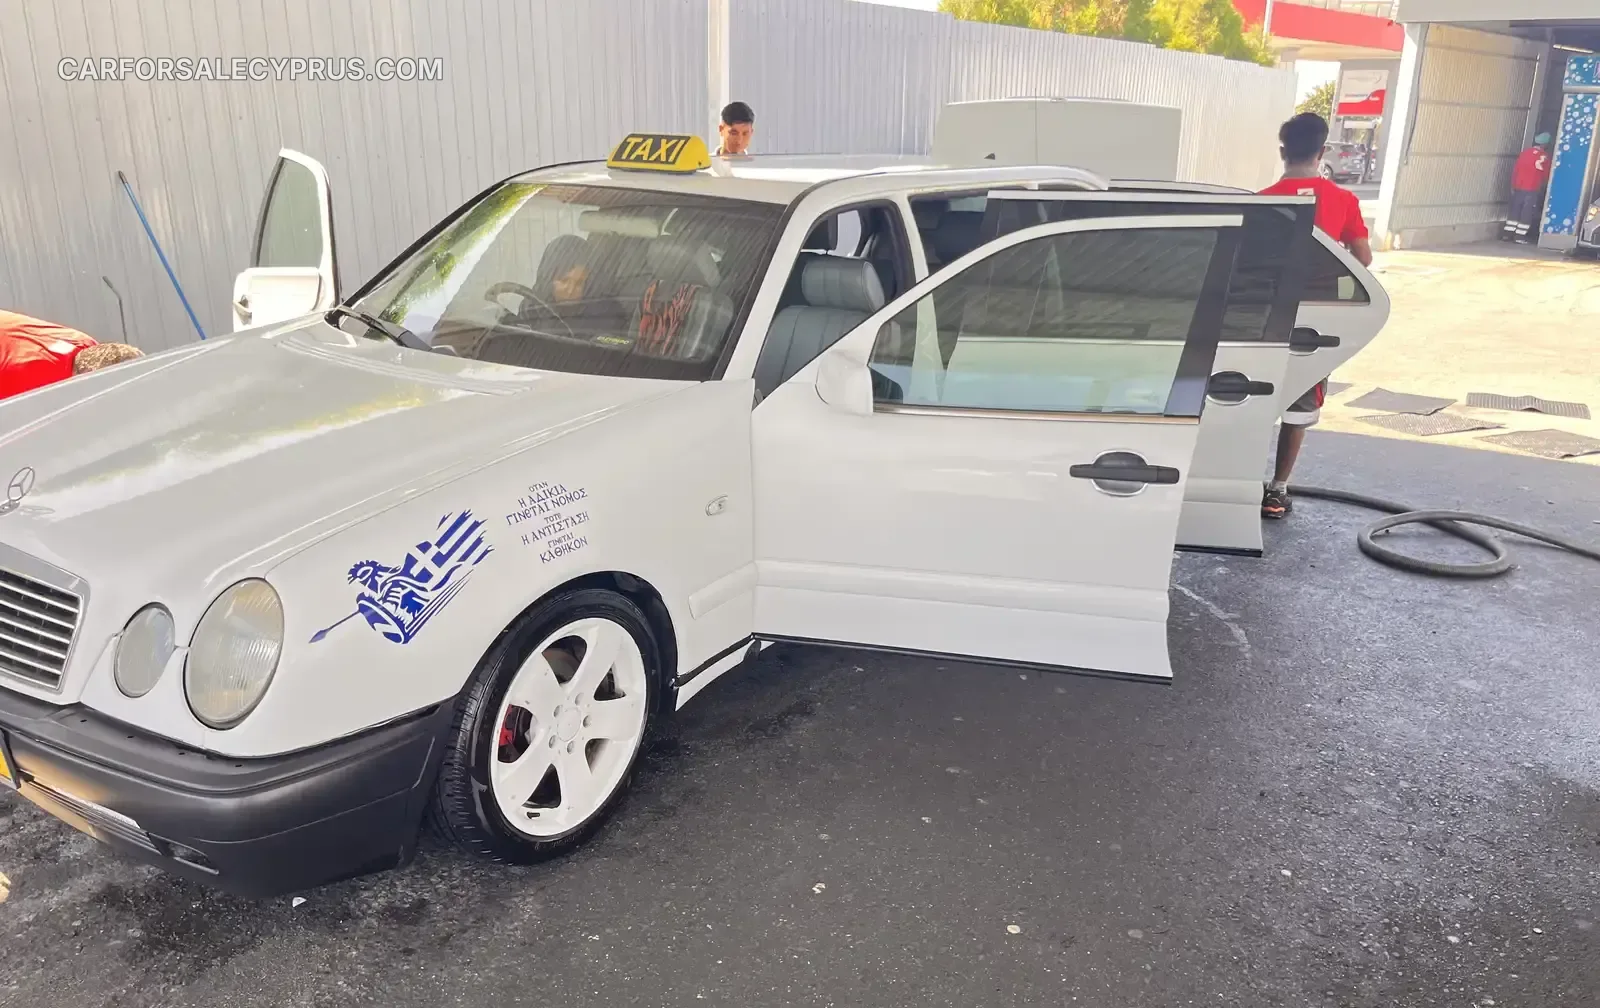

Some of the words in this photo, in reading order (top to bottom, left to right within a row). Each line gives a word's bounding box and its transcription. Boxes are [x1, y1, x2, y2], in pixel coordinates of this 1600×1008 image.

[621, 137, 686, 162] TAXI
[518, 498, 527, 508] Η
[528, 484, 567, 505] ΑΔΙΚΙΑ
[529, 481, 548, 492] ΟΤΑΝ
[551, 488, 587, 508] ΝΟΜΟΣ
[521, 534, 530, 545] Η
[532, 511, 589, 542] ΑΝΤΙΣΤΑΣΗ
[540, 536, 588, 564] ΚΑΘΗΚΟΝ
